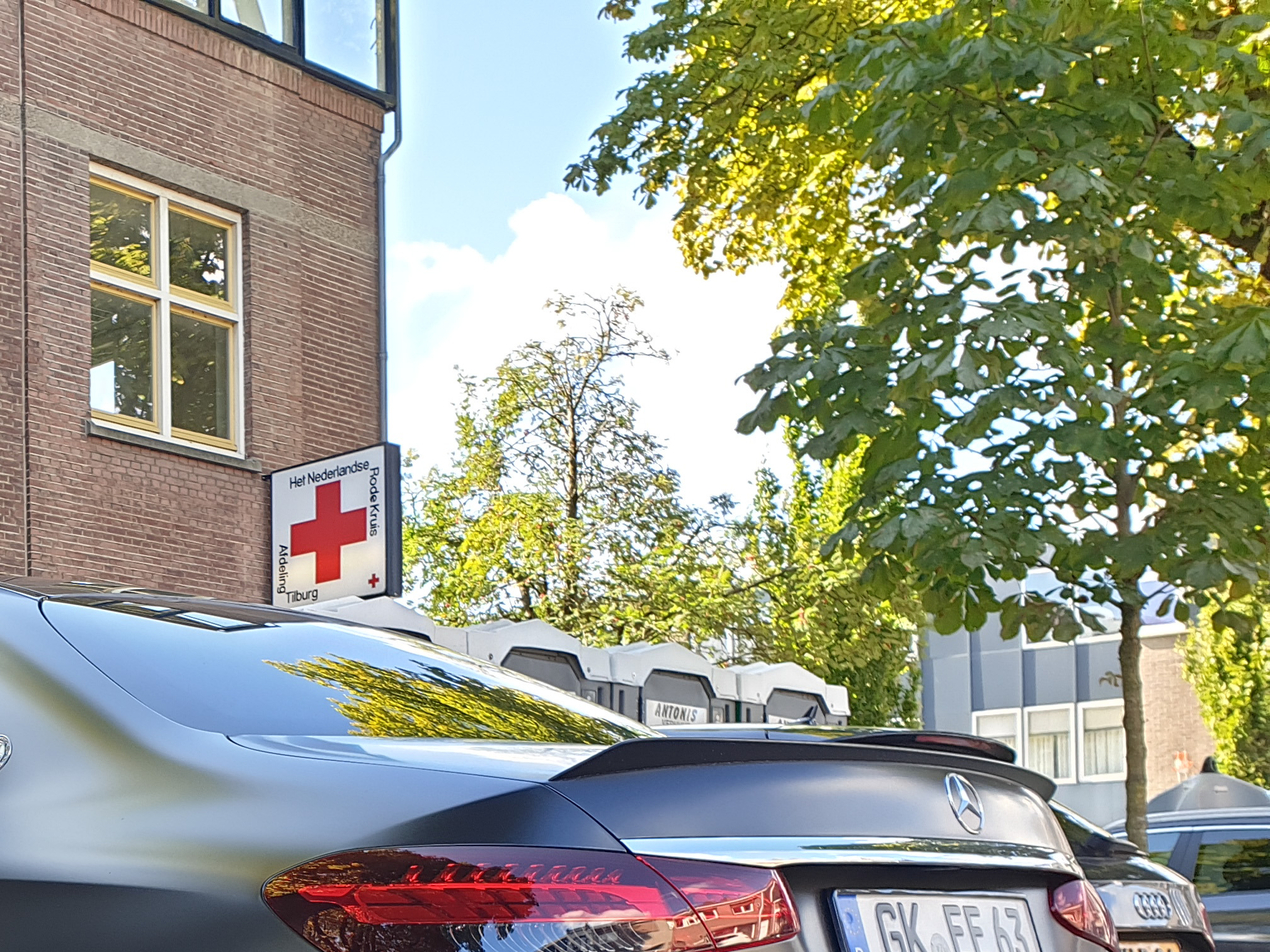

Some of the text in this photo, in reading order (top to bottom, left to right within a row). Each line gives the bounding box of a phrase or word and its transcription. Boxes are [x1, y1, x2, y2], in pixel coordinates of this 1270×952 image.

[289, 460, 370, 490] Het Nederlandse
[369, 467, 381, 537] Rode Kruis
[277, 544, 289, 594] Afdeling
[286, 588, 319, 604] Tilburg
[654, 703, 698, 722] ANTONIS
